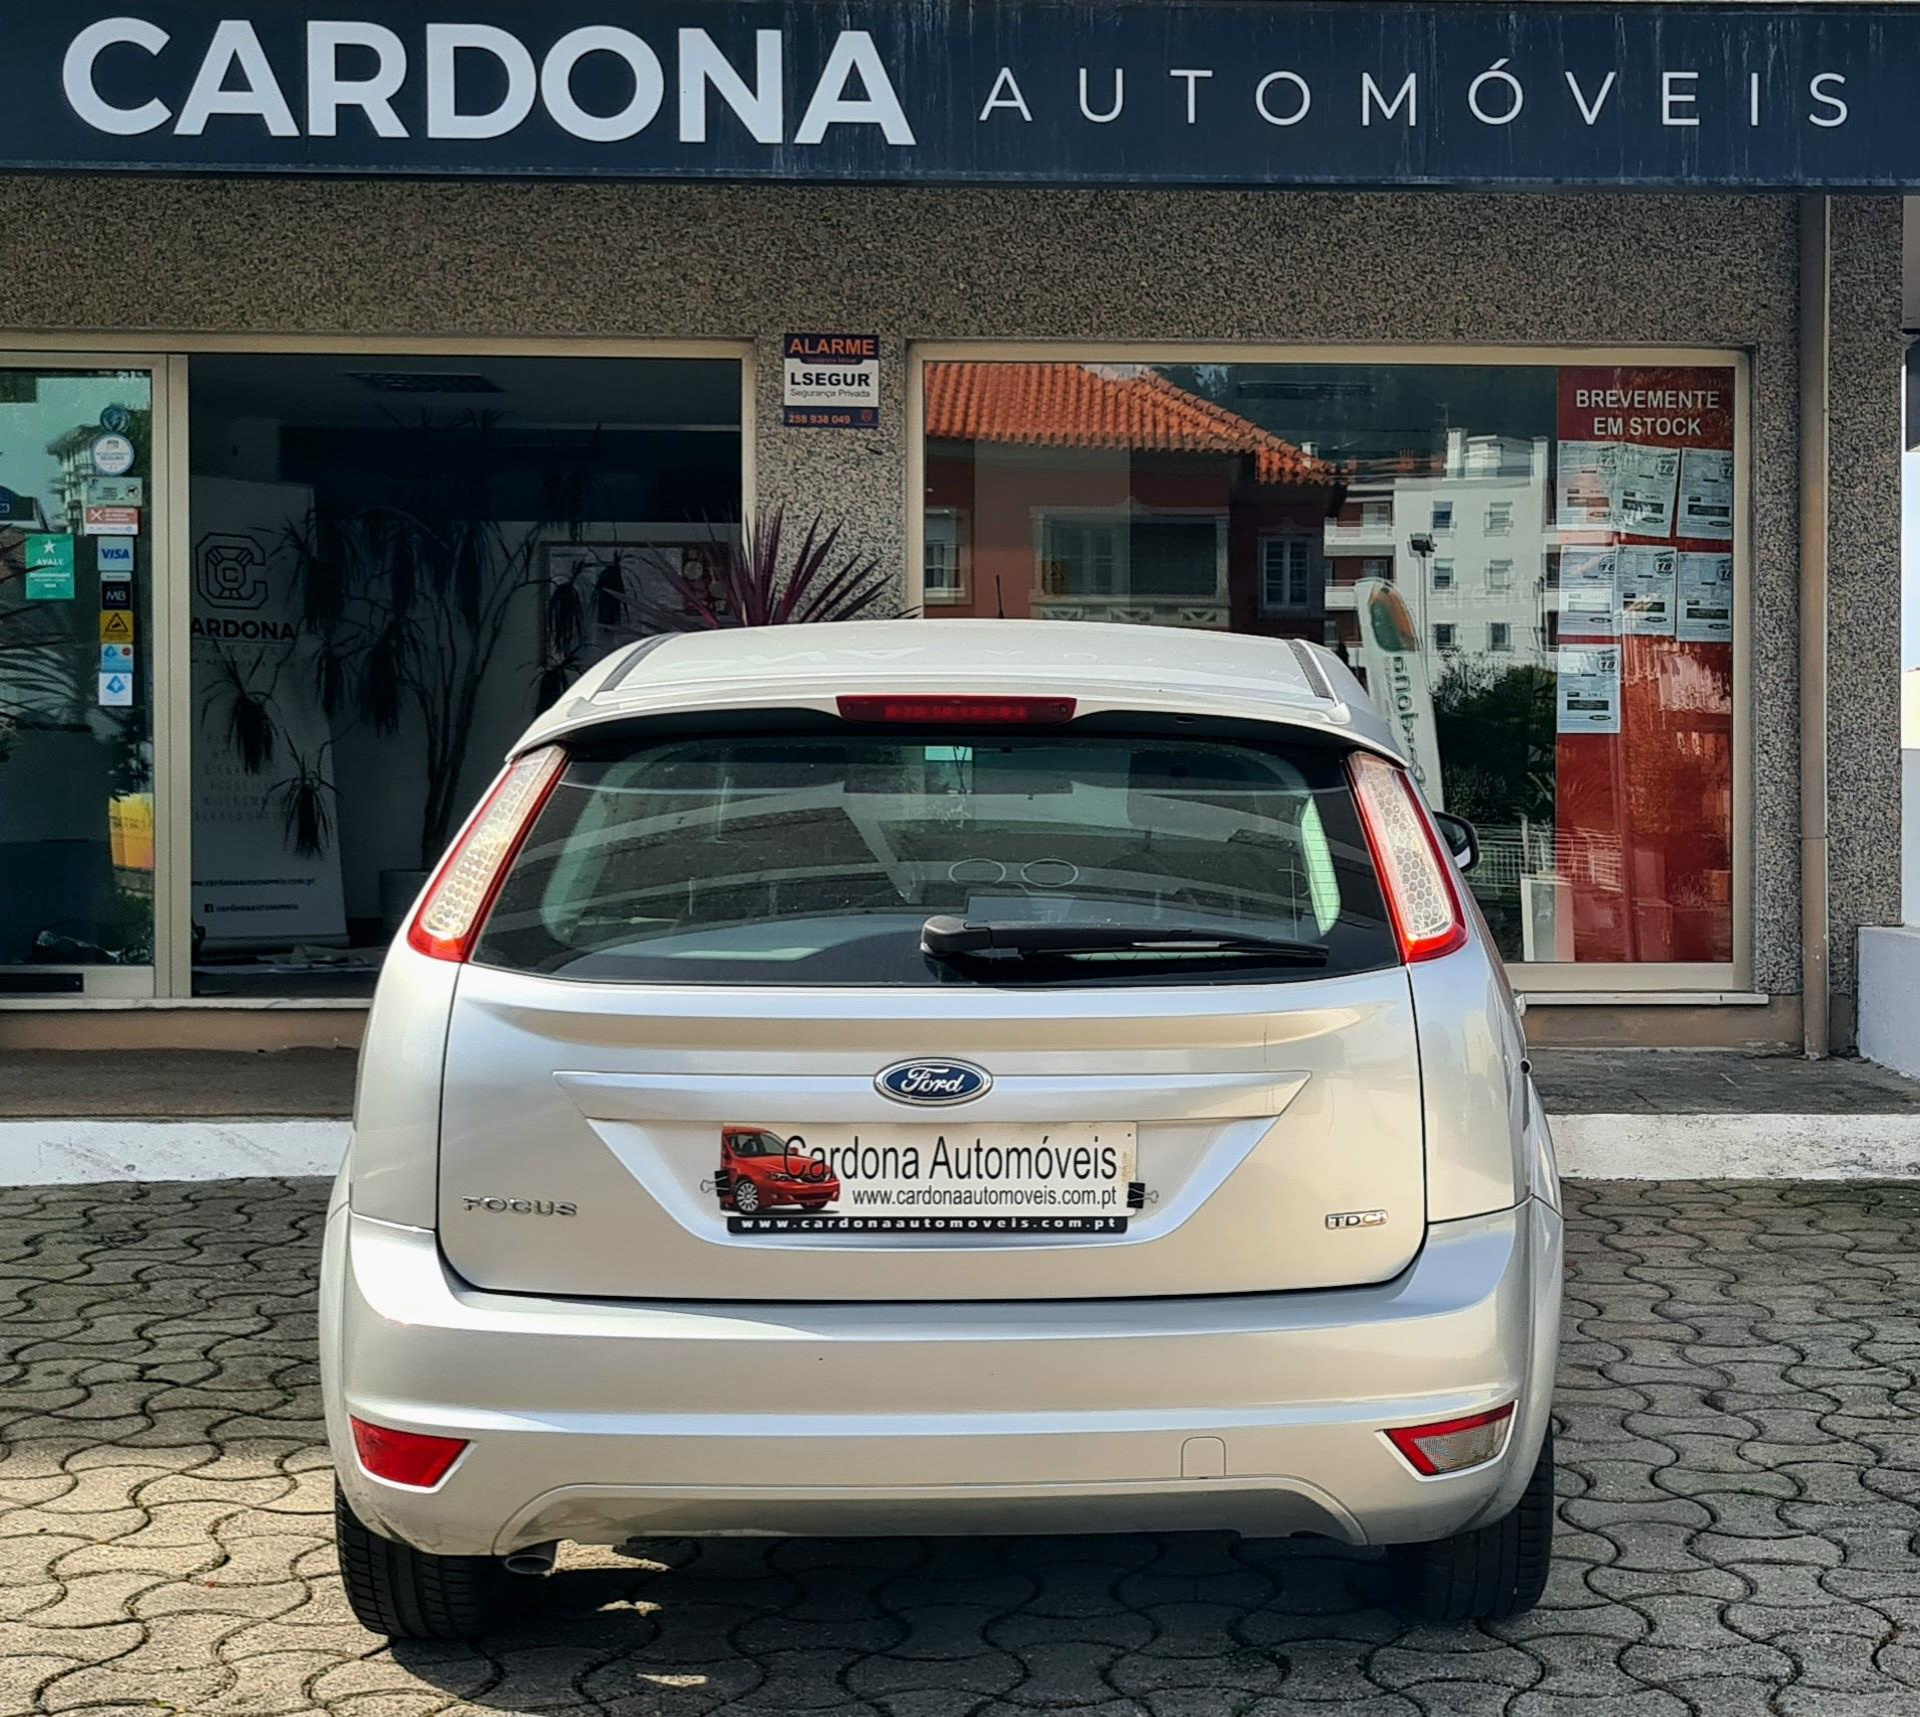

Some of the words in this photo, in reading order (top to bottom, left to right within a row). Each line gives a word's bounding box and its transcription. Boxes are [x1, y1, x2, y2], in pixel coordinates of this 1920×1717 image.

[61, 16, 917, 145] CARDONA
[979, 58, 1850, 127] AUTOMÓVEIS
[790, 339, 875, 355] ALARME
[790, 372, 870, 387] LSEGUR
[791, 388, 836, 398] Segurança
[838, 389, 870, 397] Privada
[1576, 390, 1719, 409] BREVEMENTE
[1594, 417, 1623, 436] EM
[1630, 417, 1701, 436] STOCK
[101, 549, 130, 559] VISA
[190, 617, 297, 640] ARDONA
[901, 1067, 965, 1095] Ford
[783, 1136, 919, 1180] Cardona
[929, 1136, 1118, 1180] Automóveis
[462, 1195, 578, 1217] FOCUS
[852, 1185, 1117, 1209] www.cardonaautomoveis.com.pt
[741, 1217, 1116, 1230] www.cardonaautomoveis.com.pt
